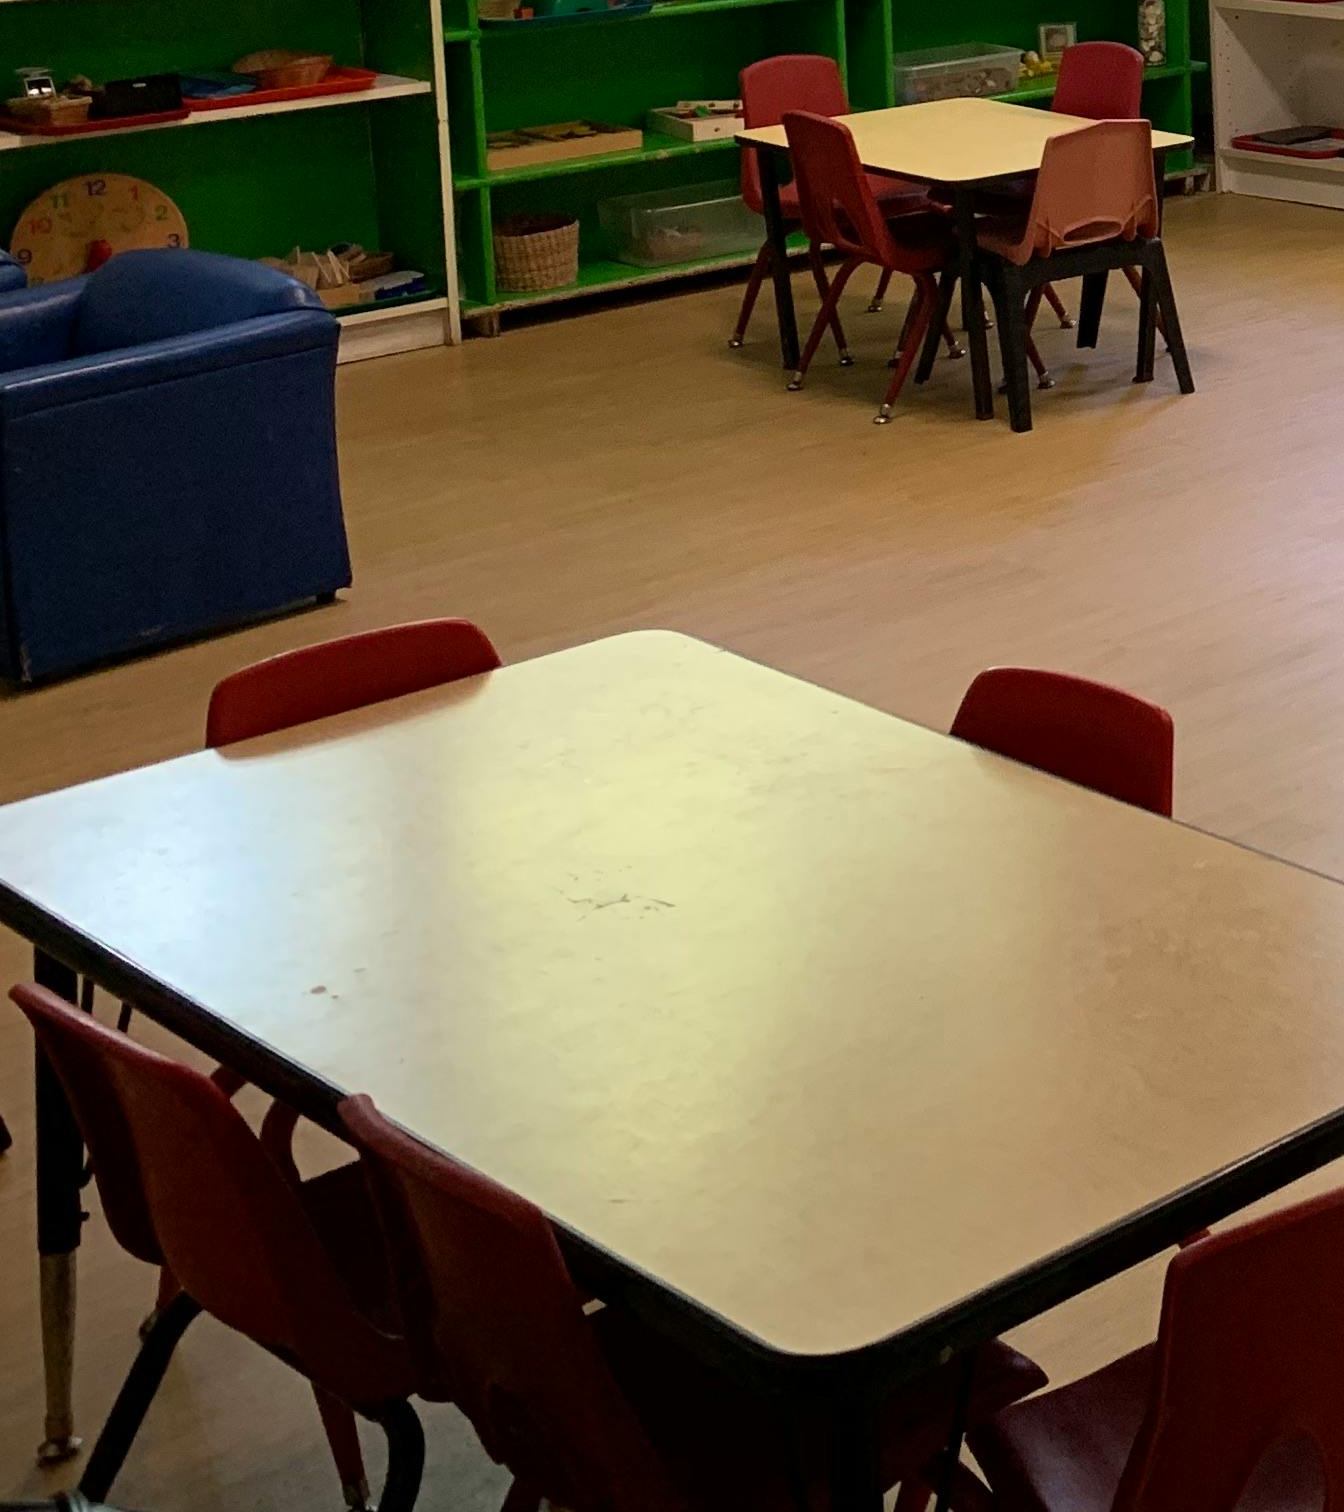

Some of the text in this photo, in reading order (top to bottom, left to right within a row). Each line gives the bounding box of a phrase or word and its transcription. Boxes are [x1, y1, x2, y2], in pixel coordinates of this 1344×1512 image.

[86, 179, 106, 196] 12
[129, 185, 138, 201] 1
[156, 205, 168, 220] 2
[168, 234, 180, 248] 3
[17, 249, 32, 264] 9
